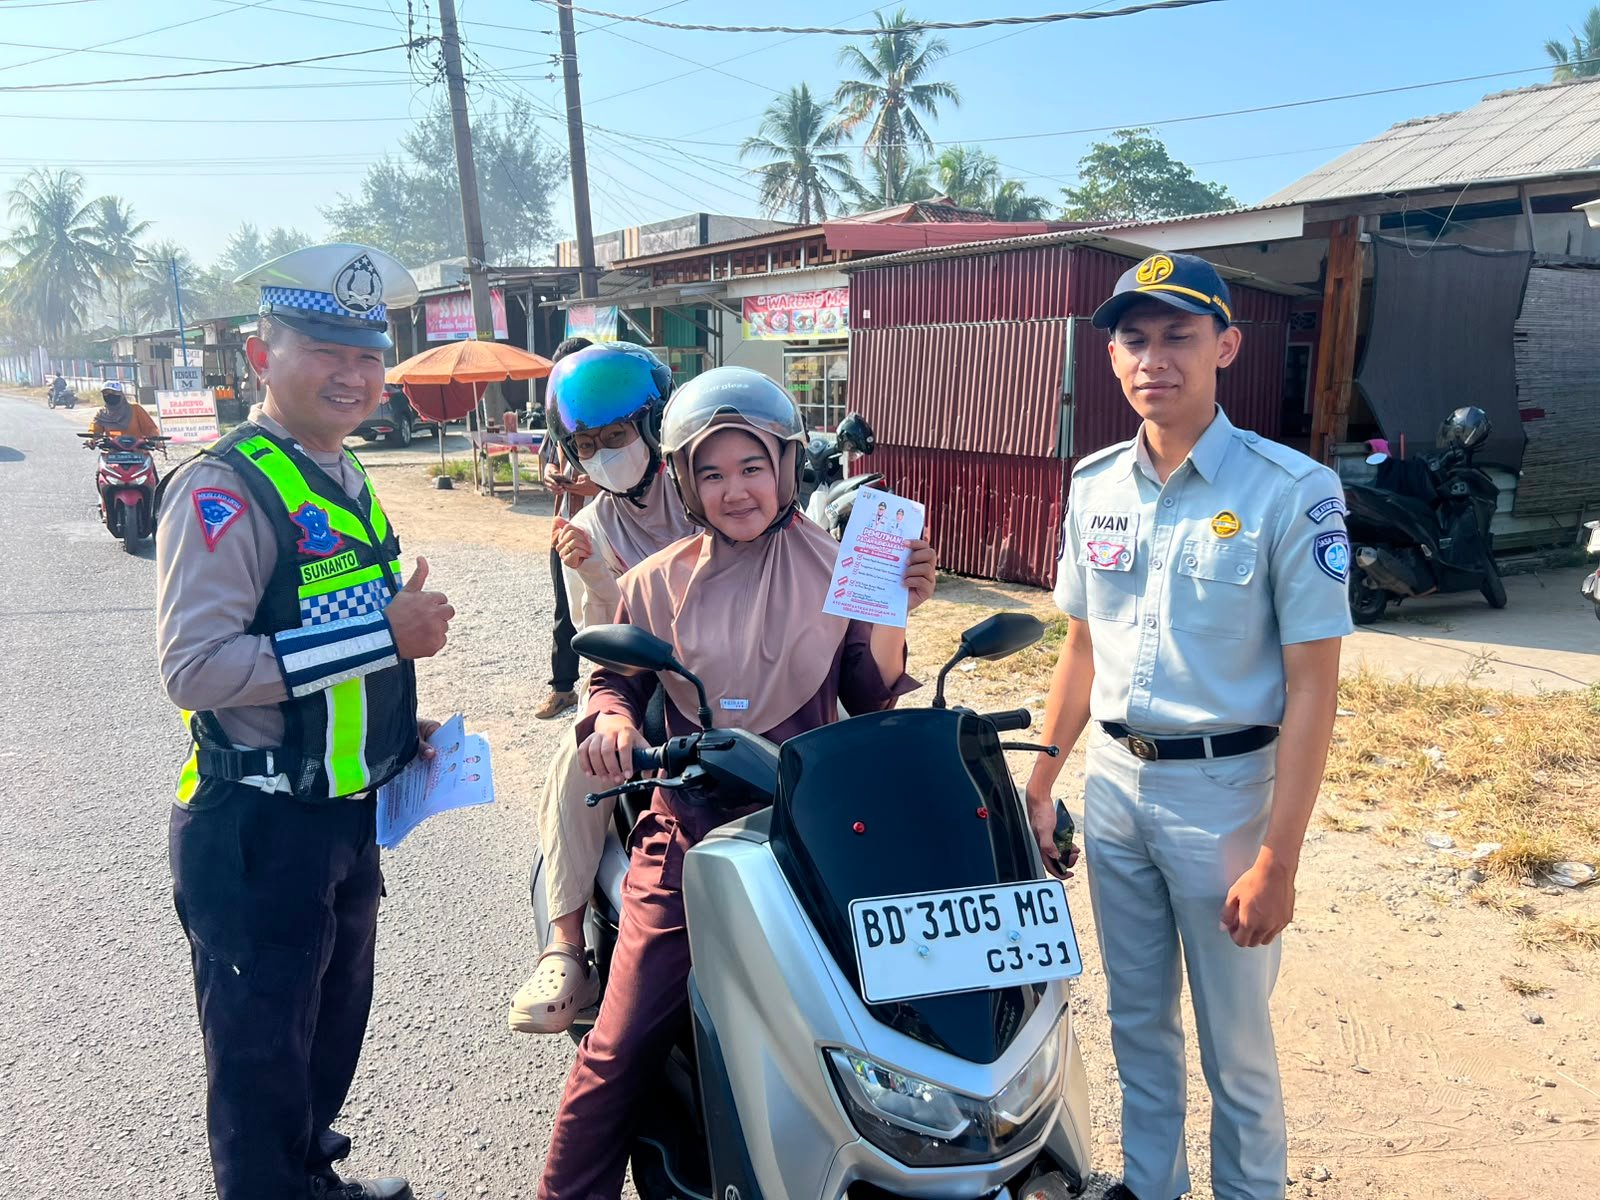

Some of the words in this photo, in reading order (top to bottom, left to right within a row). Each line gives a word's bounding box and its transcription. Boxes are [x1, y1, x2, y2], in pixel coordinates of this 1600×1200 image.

[452, 296, 473, 317] STO
[767, 292, 823, 311] WARUNG
[1090, 514, 1129, 532] IVAN
[302, 552, 356, 582] SUNANTO
[861, 905, 906, 948] BD
[916, 893, 1001, 940] 3105
[1013, 888, 1059, 928] MG
